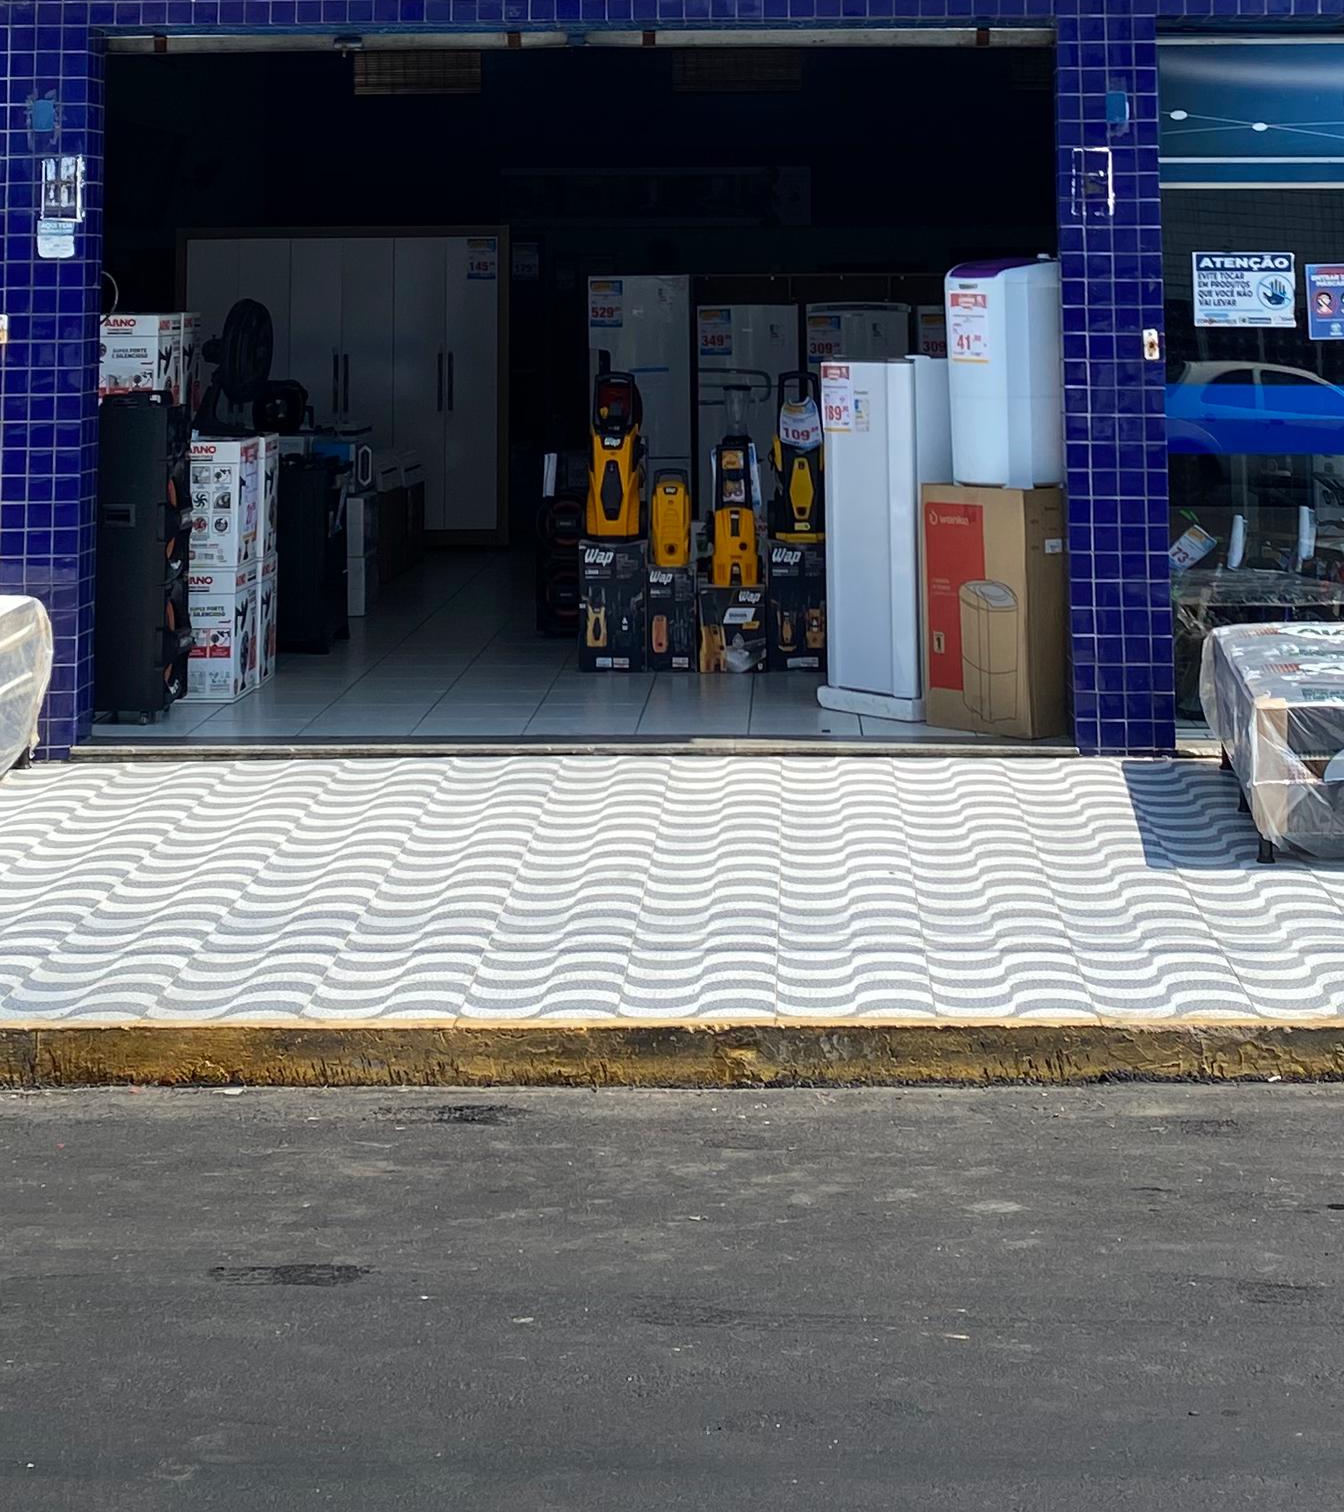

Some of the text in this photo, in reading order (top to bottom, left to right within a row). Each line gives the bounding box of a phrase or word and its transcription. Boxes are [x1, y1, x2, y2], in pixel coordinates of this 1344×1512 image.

[1198, 254, 1290, 271] ATENÇÃO
[1198, 271, 1245, 280] EVITE TOCAR
[1210, 280, 1250, 289] PRODUTOS
[1198, 287, 1253, 299] QUE VOCÊ NÃO
[1214, 298, 1237, 307] LEVAR
[104, 318, 137, 328] ARNO
[783, 427, 810, 441] 109
[584, 548, 614, 567] Wap
[771, 547, 802, 566] Wap
[189, 576, 213, 585] RNO
[649, 571, 673, 585] Wap
[738, 590, 762, 604] Wap
